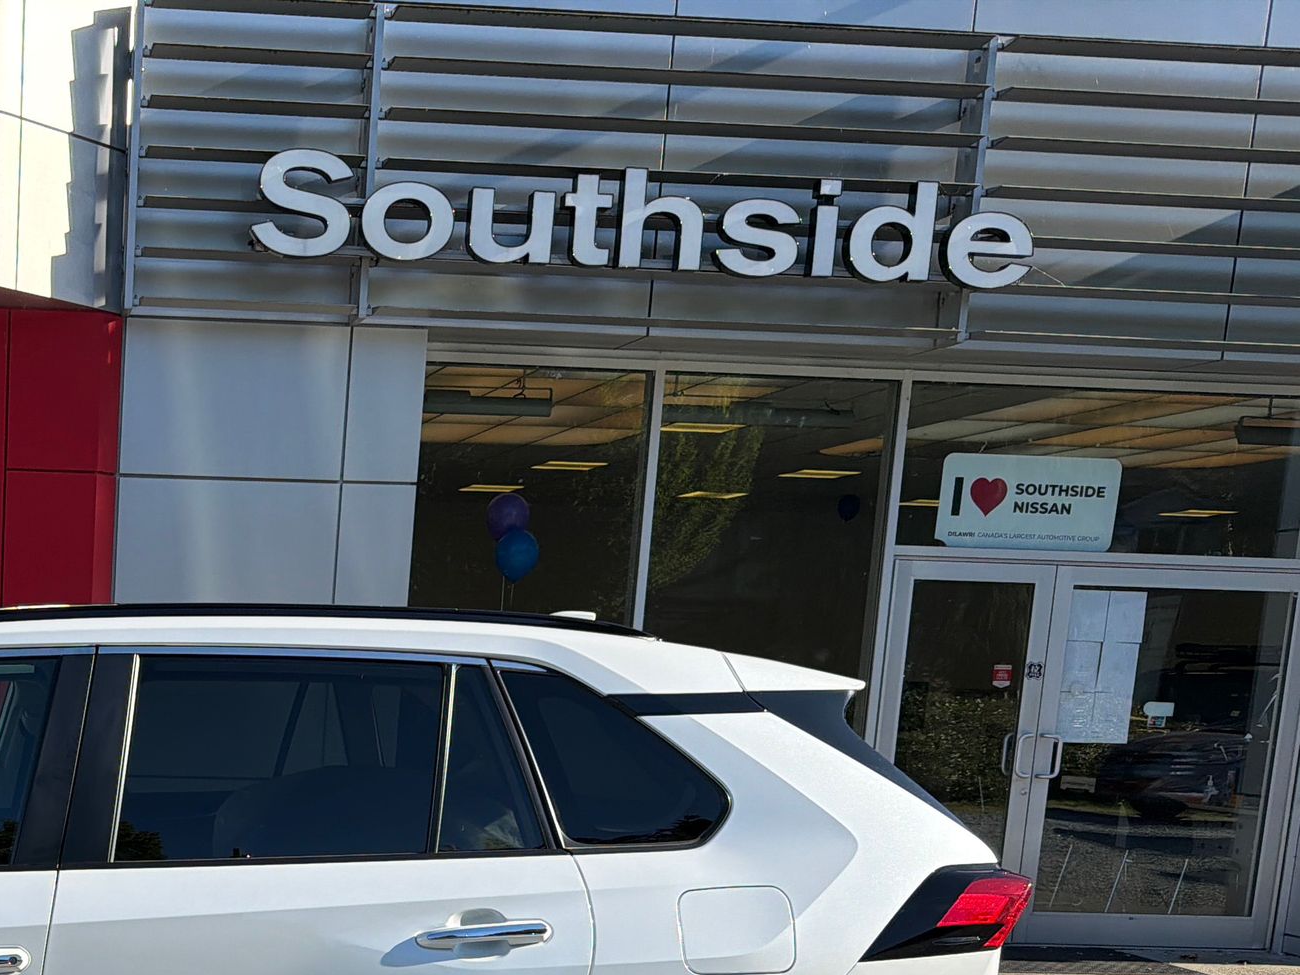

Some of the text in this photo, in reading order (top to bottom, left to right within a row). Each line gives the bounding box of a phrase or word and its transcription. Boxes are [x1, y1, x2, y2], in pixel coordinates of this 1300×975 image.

[248, 147, 1034, 290] Southside
[950, 476, 965, 516] I
[1015, 483, 1107, 498] SOUTHSIDE
[1012, 501, 1072, 515] NISSAN
[1036, 534, 1077, 542] AUTOMOTIVE
[1077, 535, 1100, 543] GROUP
